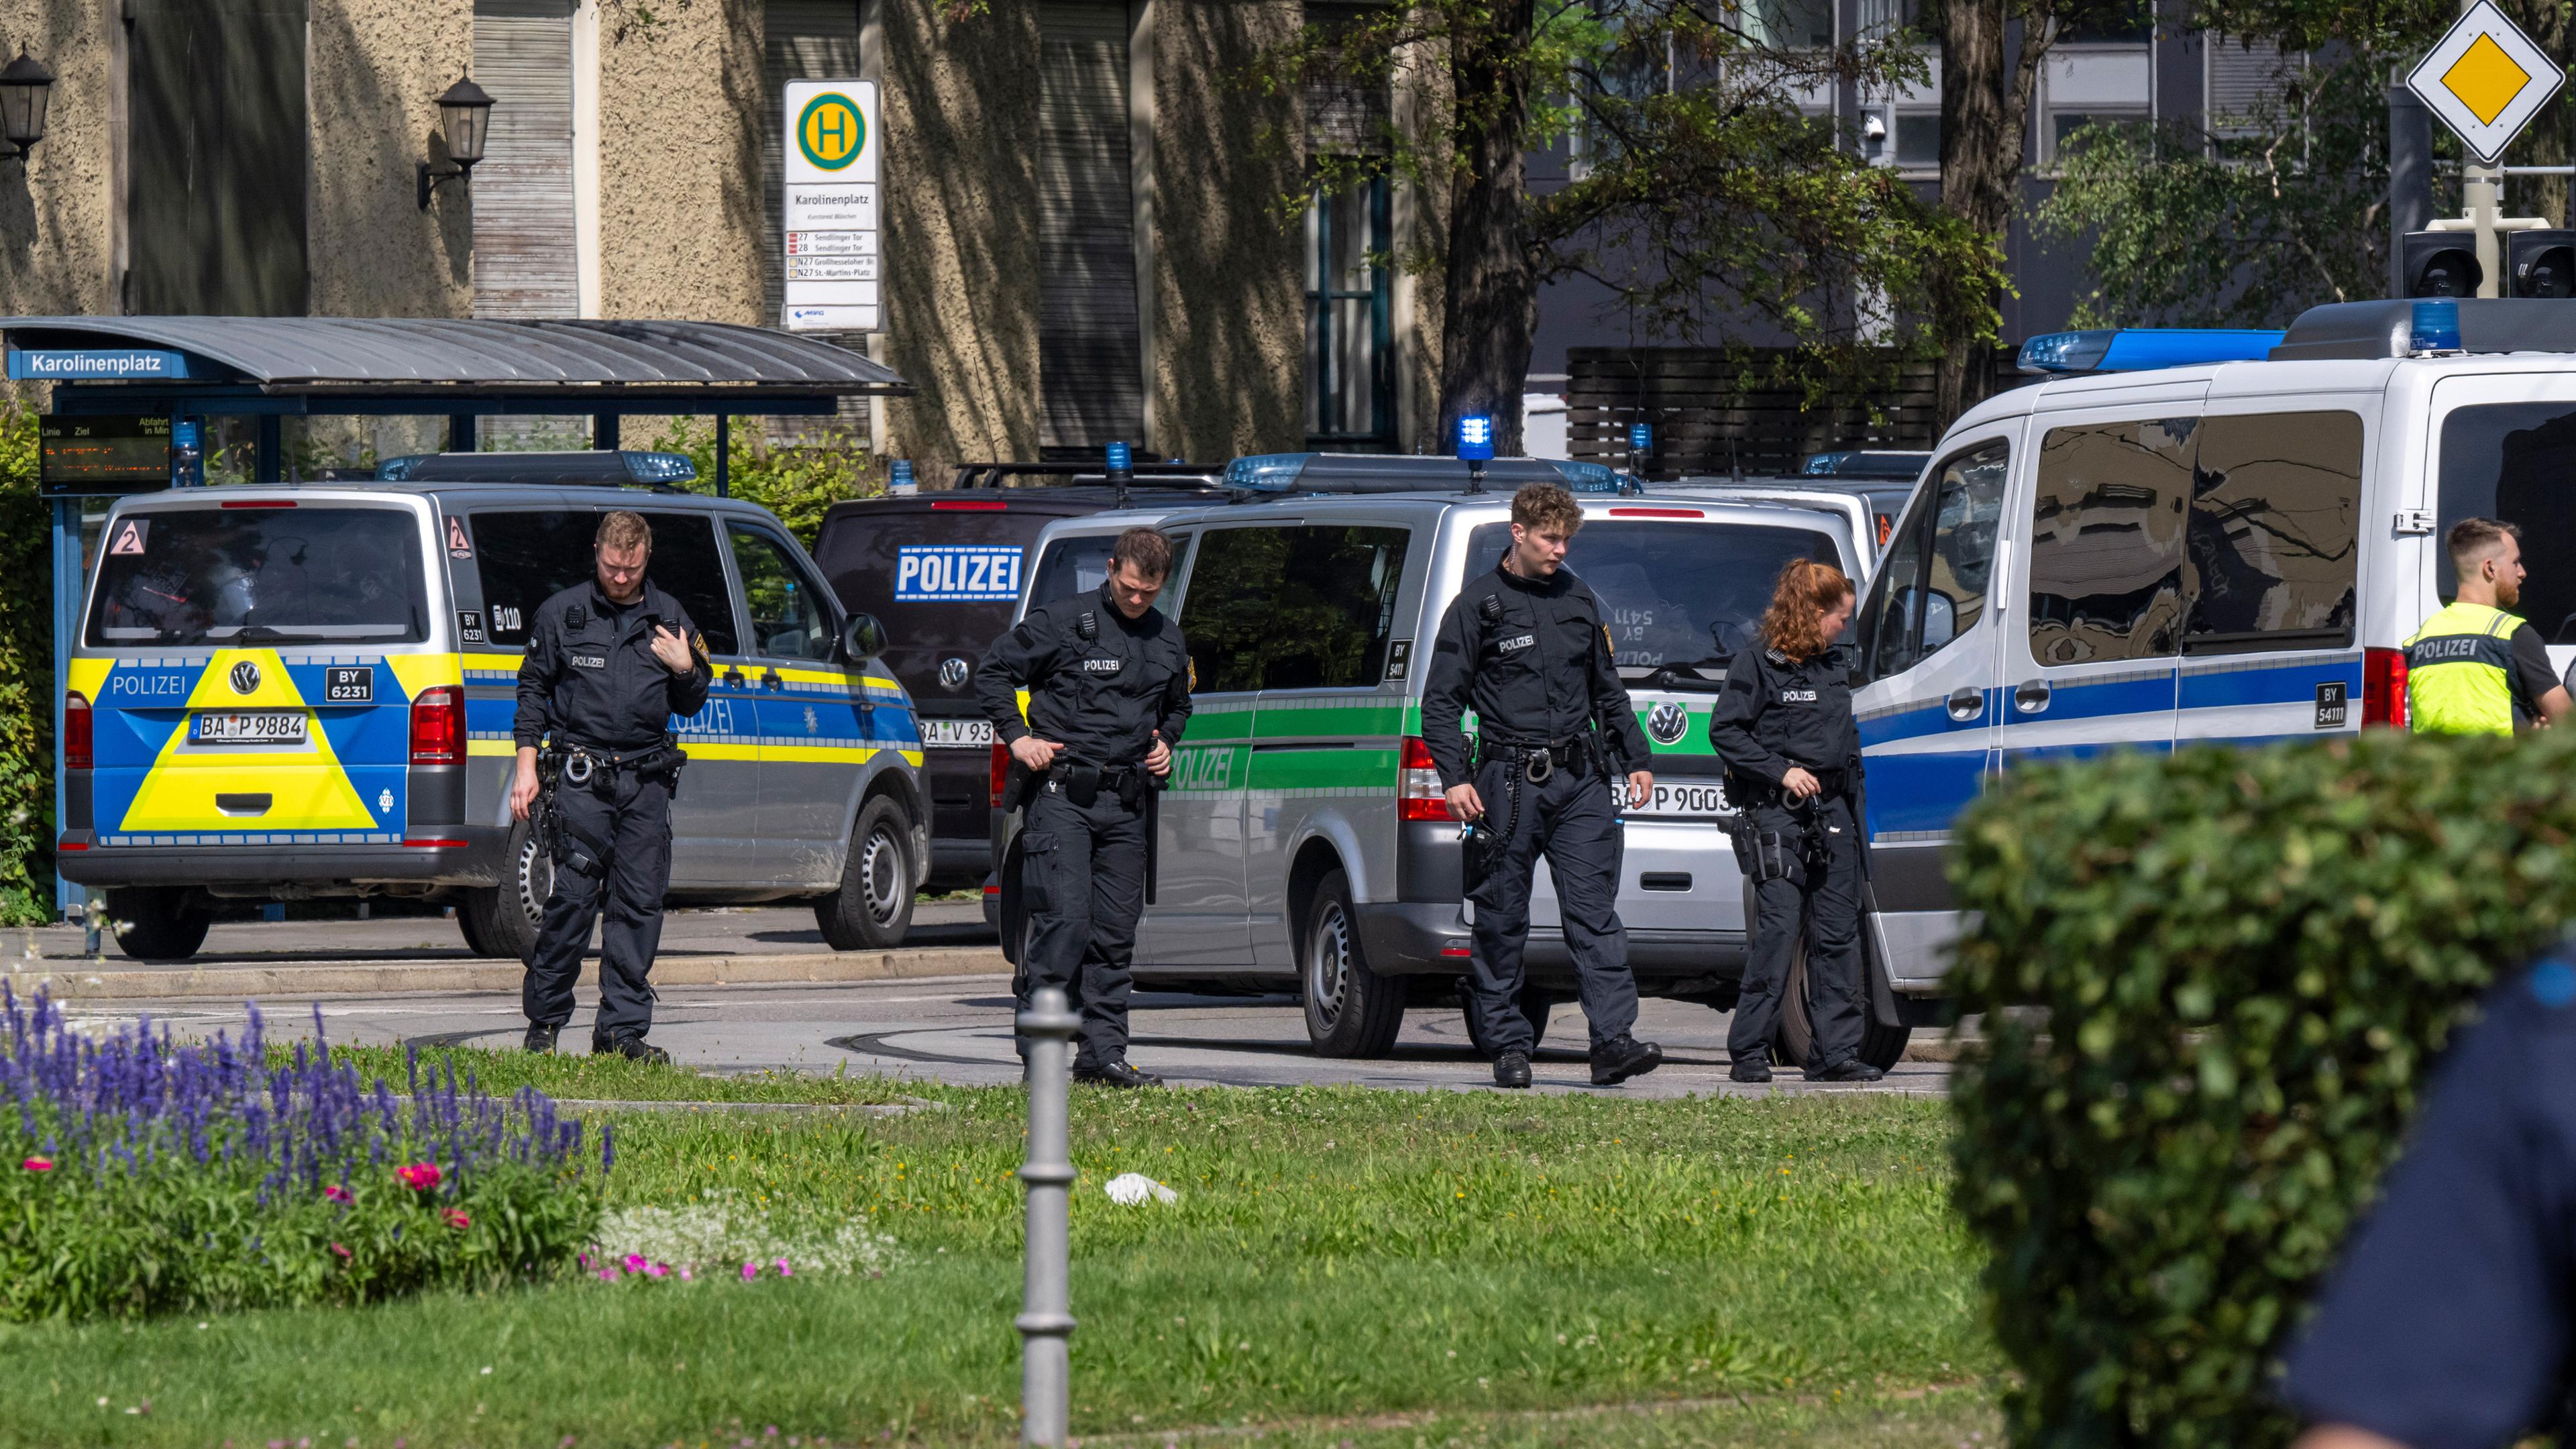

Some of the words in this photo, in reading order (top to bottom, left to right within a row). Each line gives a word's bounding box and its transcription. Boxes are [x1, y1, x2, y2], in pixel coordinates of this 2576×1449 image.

[818, 111, 845, 152] H
[796, 195, 869, 206] Karolinenplatz
[32, 355, 161, 374] Karolinenplatz
[139, 418, 168, 426] Abfahrt
[42, 427, 61, 436] Linie
[74, 427, 89, 435] Ziel
[121, 530, 136, 552] 2
[452, 526, 463, 547] 2
[898, 555, 1020, 592] POLIZEI
[464, 614, 475, 626] BY
[504, 607, 521, 630] 110
[1615, 608, 1653, 625] 5411
[464, 630, 483, 641] 6231
[1395, 645, 1405, 657] BY
[1499, 635, 1534, 653] POLIZEI
[2415, 639, 2478, 661] POLIZEI
[572, 655, 604, 668] POLIZEI
[1084, 659, 1119, 672] POLIZEI
[1389, 663, 1404, 676] 5411
[339, 671, 359, 683] BY
[113, 676, 185, 695] POLIZEI
[331, 686, 367, 698] 6231
[1783, 690, 1817, 702] POLIZEI
[2324, 688, 2337, 702] BY
[671, 698, 733, 734] OLIZEI
[2318, 707, 2344, 722] 54111
[201, 716, 225, 736] BA
[239, 716, 251, 735] P
[256, 716, 301, 735] 9884
[953, 723, 963, 741] V
[970, 723, 991, 741] 93
[1654, 787, 1669, 810] P
[1675, 788, 1731, 812] 9003
